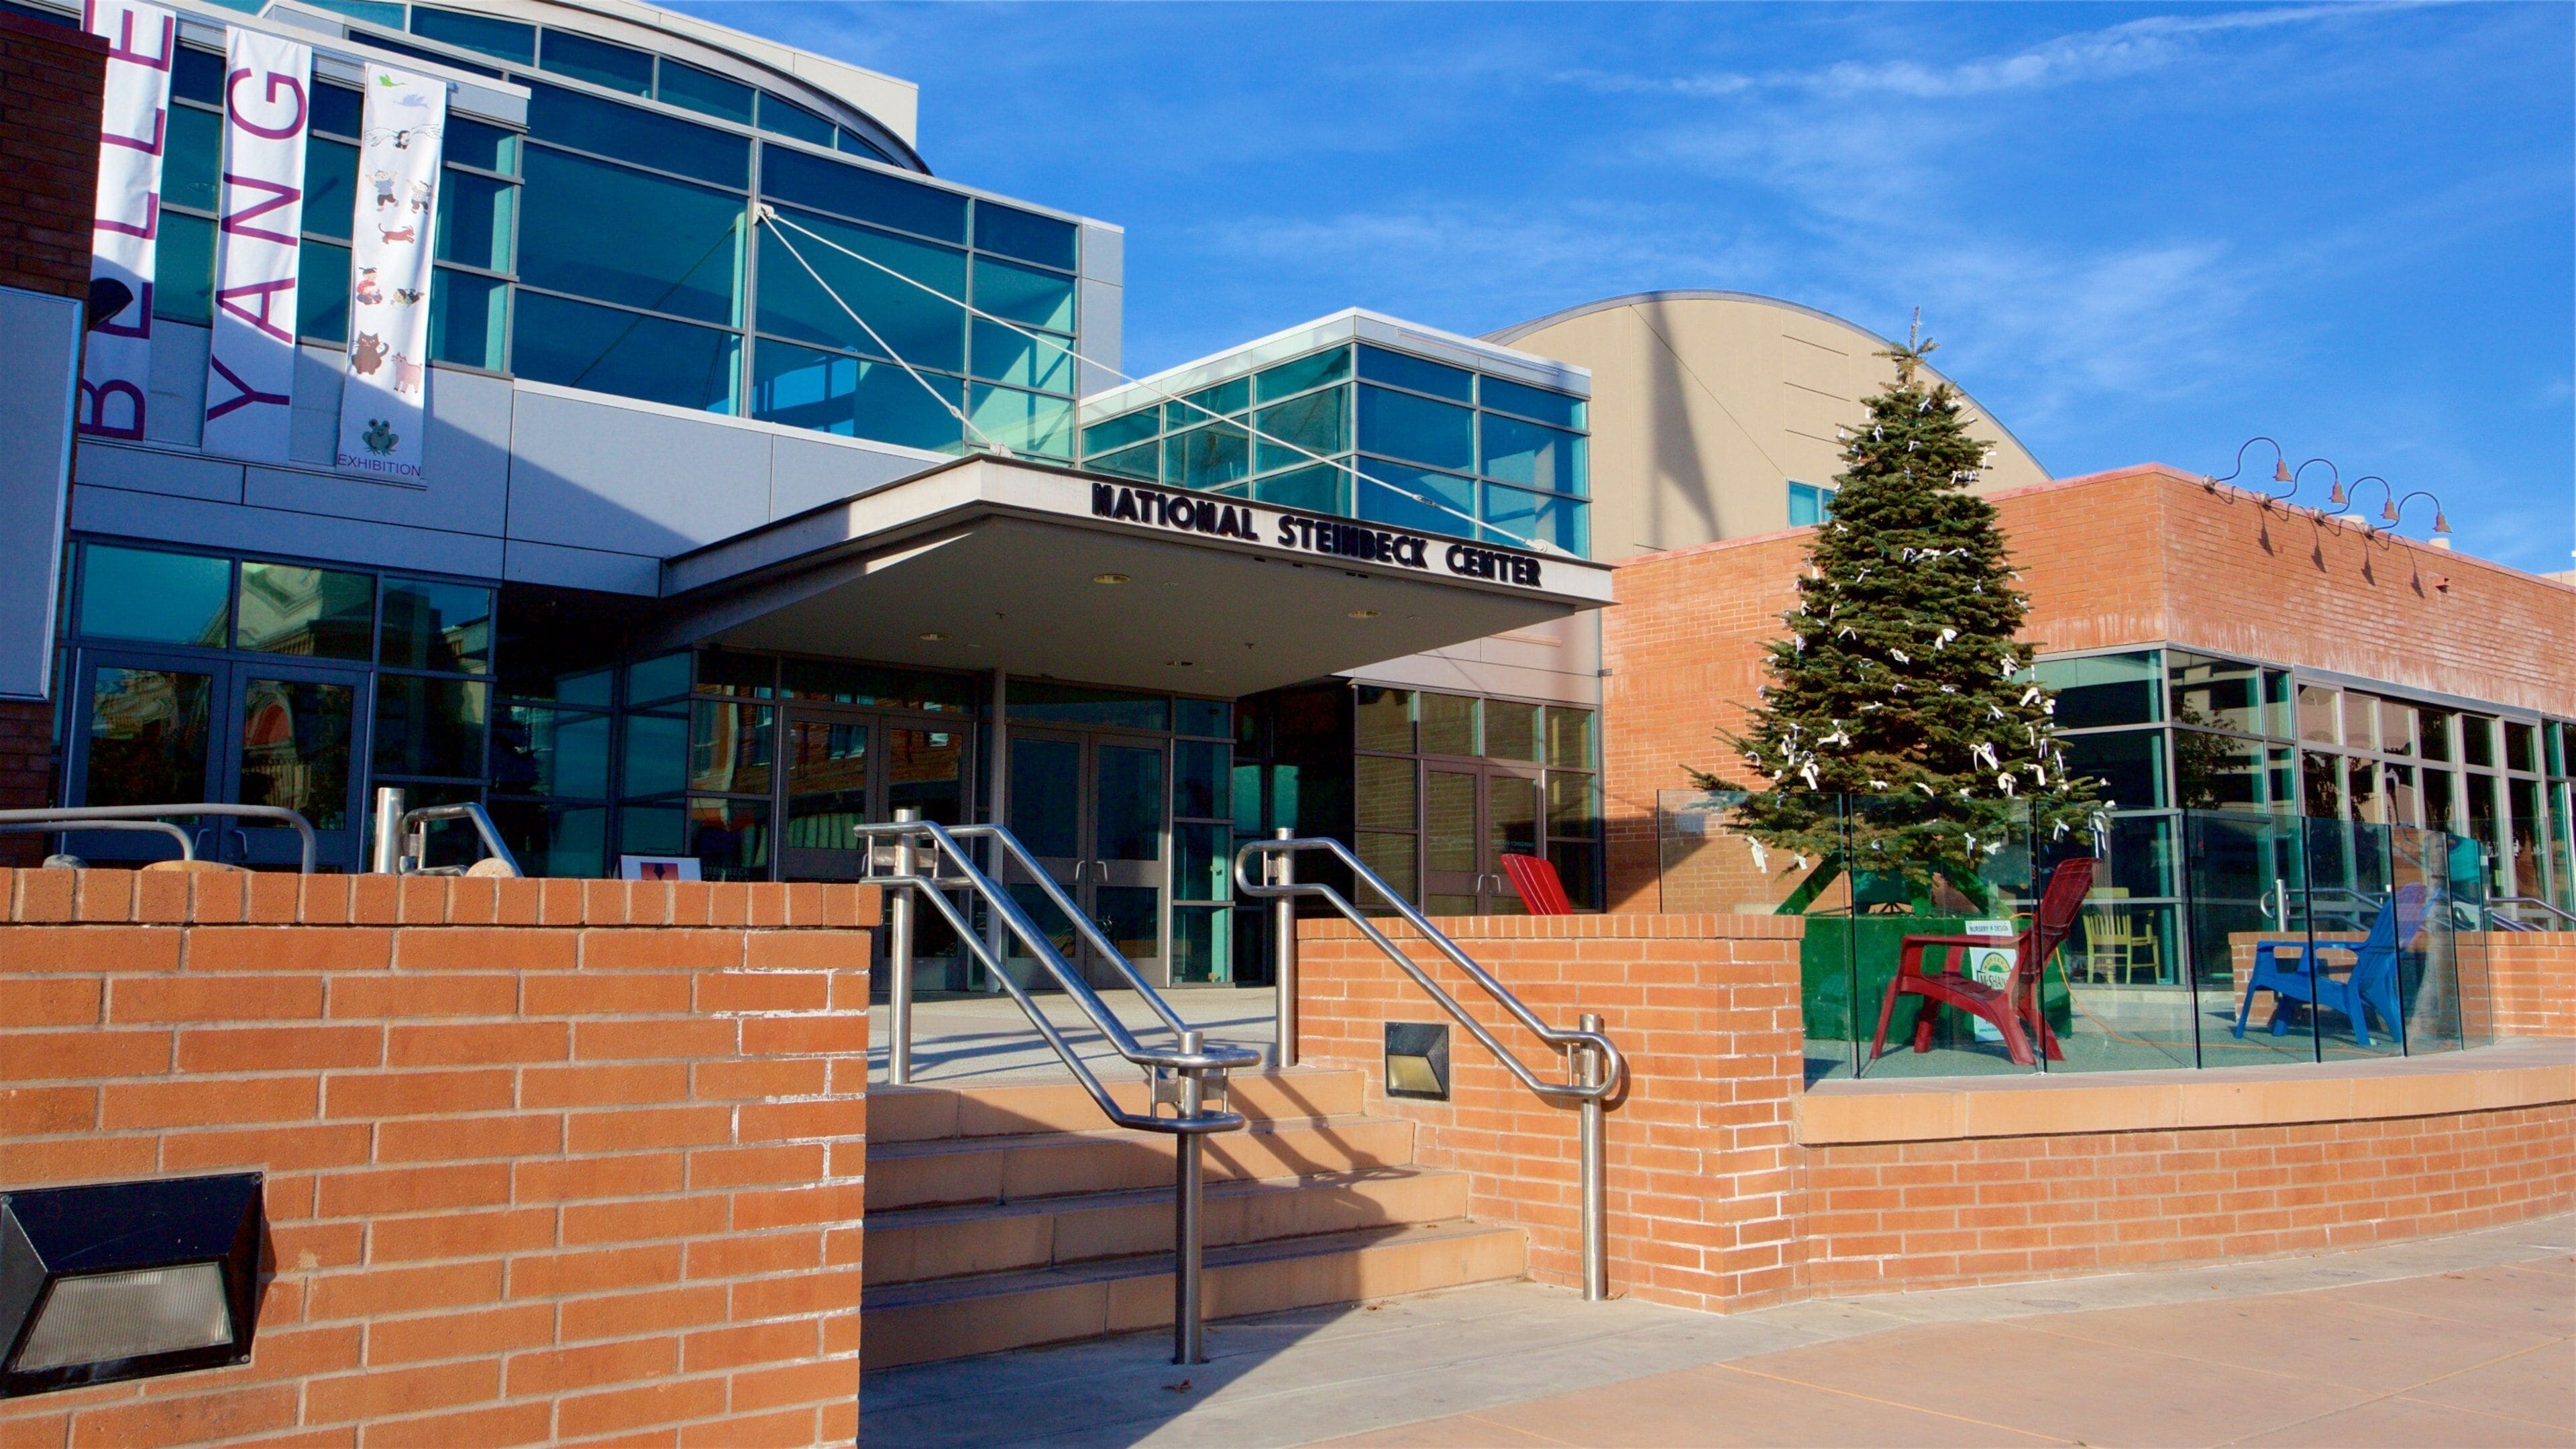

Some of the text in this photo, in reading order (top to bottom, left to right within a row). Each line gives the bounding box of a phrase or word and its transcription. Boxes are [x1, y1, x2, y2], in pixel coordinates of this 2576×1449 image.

[206, 67, 308, 422] YANG
[337, 453, 421, 477] EXHIBITION
[1091, 482, 1542, 588] NATIONAL STEINBECK CENTER
